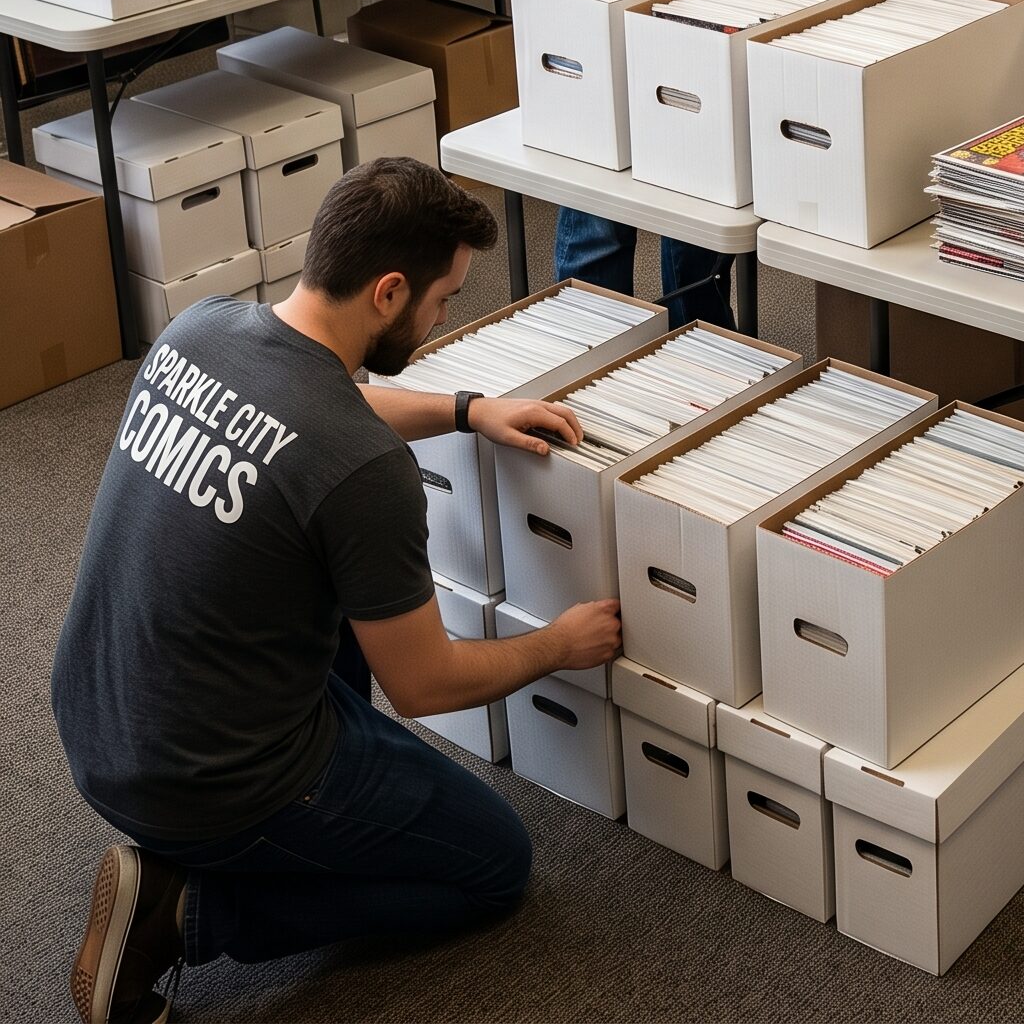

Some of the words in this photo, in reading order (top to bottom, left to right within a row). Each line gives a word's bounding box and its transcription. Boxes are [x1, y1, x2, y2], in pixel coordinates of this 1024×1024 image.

[119, 389, 258, 524] COMICS
[143, 343, 239, 430] SPARKLE
[224, 403, 299, 466] CITY
